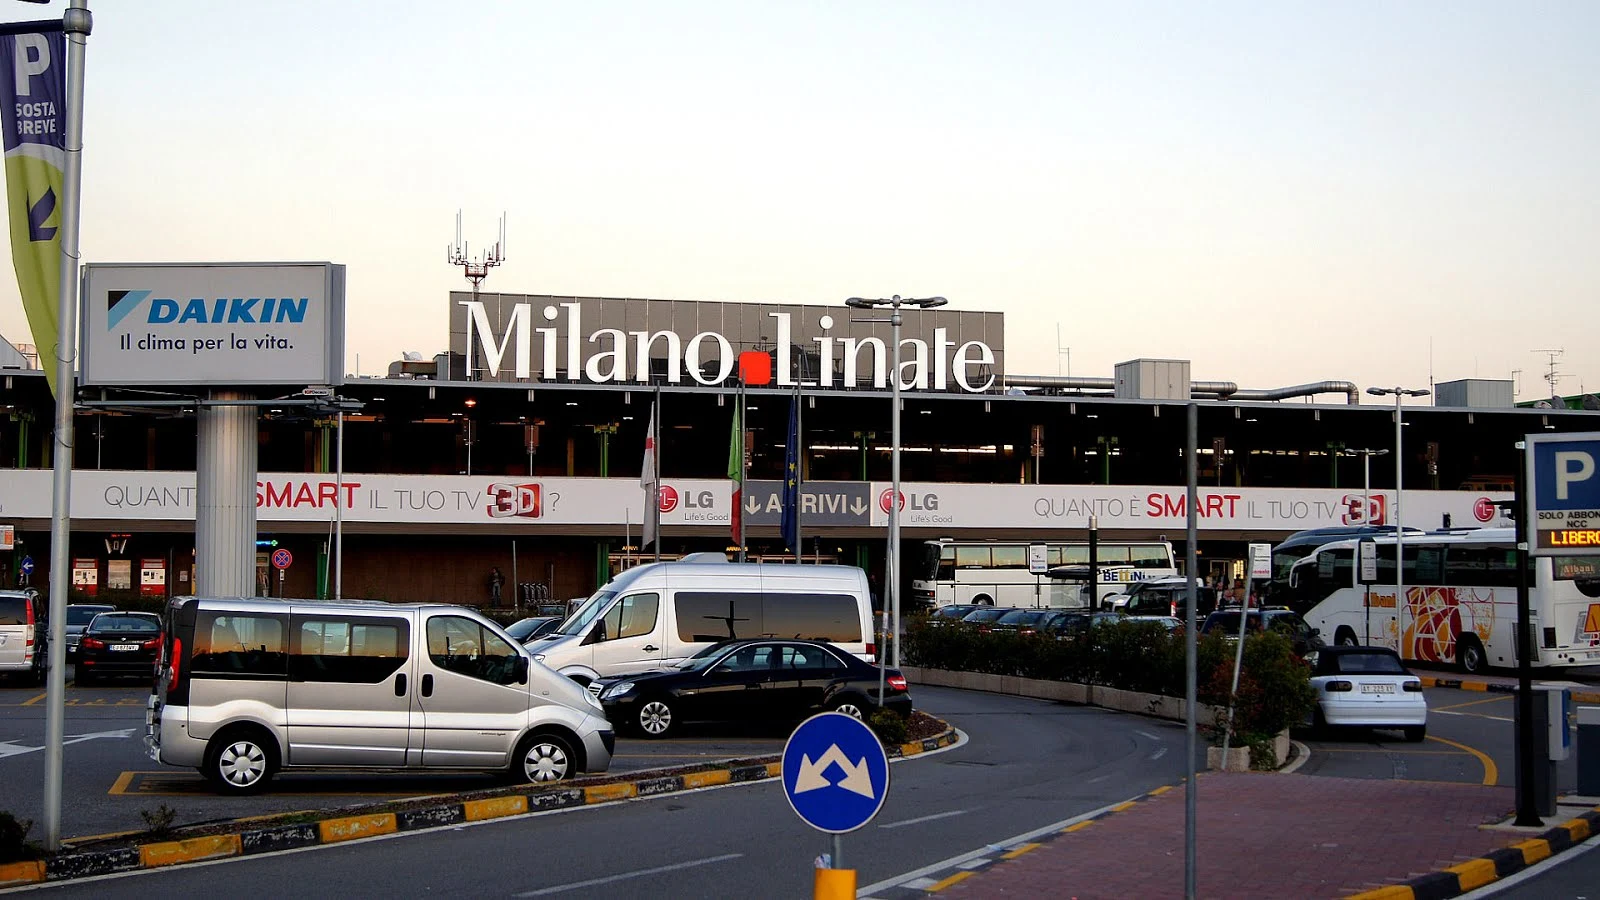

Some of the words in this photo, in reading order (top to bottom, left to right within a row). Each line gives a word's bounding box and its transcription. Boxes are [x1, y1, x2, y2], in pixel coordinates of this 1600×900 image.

[15, 33, 50, 96] P
[16, 101, 56, 118] SOSTA
[17, 119, 56, 135] BREVE
[147, 298, 308, 324] DAIKIN
[120, 333, 131, 350] Il
[137, 333, 185, 350] clima
[193, 337, 224, 354] per
[230, 333, 247, 350] la
[254, 334, 294, 350] vita.
[458, 299, 734, 385] Milano
[768, 312, 996, 393] Linate
[1555, 451, 1595, 500] P
[104, 485, 196, 509] QUANT
[369, 490, 388, 509] IL
[394, 490, 445, 510] TUO
[451, 491, 481, 510] TV
[487, 483, 541, 518] 3D
[549, 492, 561, 512] ?
[684, 491, 713, 508] LG
[765, 493, 847, 513] ARIVI
[910, 493, 939, 511] LG
[684, 513, 705, 521] Life's
[706, 513, 729, 521] Good
[910, 515, 931, 523] Life's
[932, 515, 953, 523] Good
[1034, 497, 1124, 518] QUANTO
[1247, 501, 1263, 519] IL
[1267, 501, 1309, 519] TUO
[1313, 502, 1337, 520] TV
[1342, 494, 1384, 526] 3D
[1538, 511, 1564, 520] SOLO
[1566, 520, 1588, 528] NCC
[1563, 564, 1593, 573] Albani
